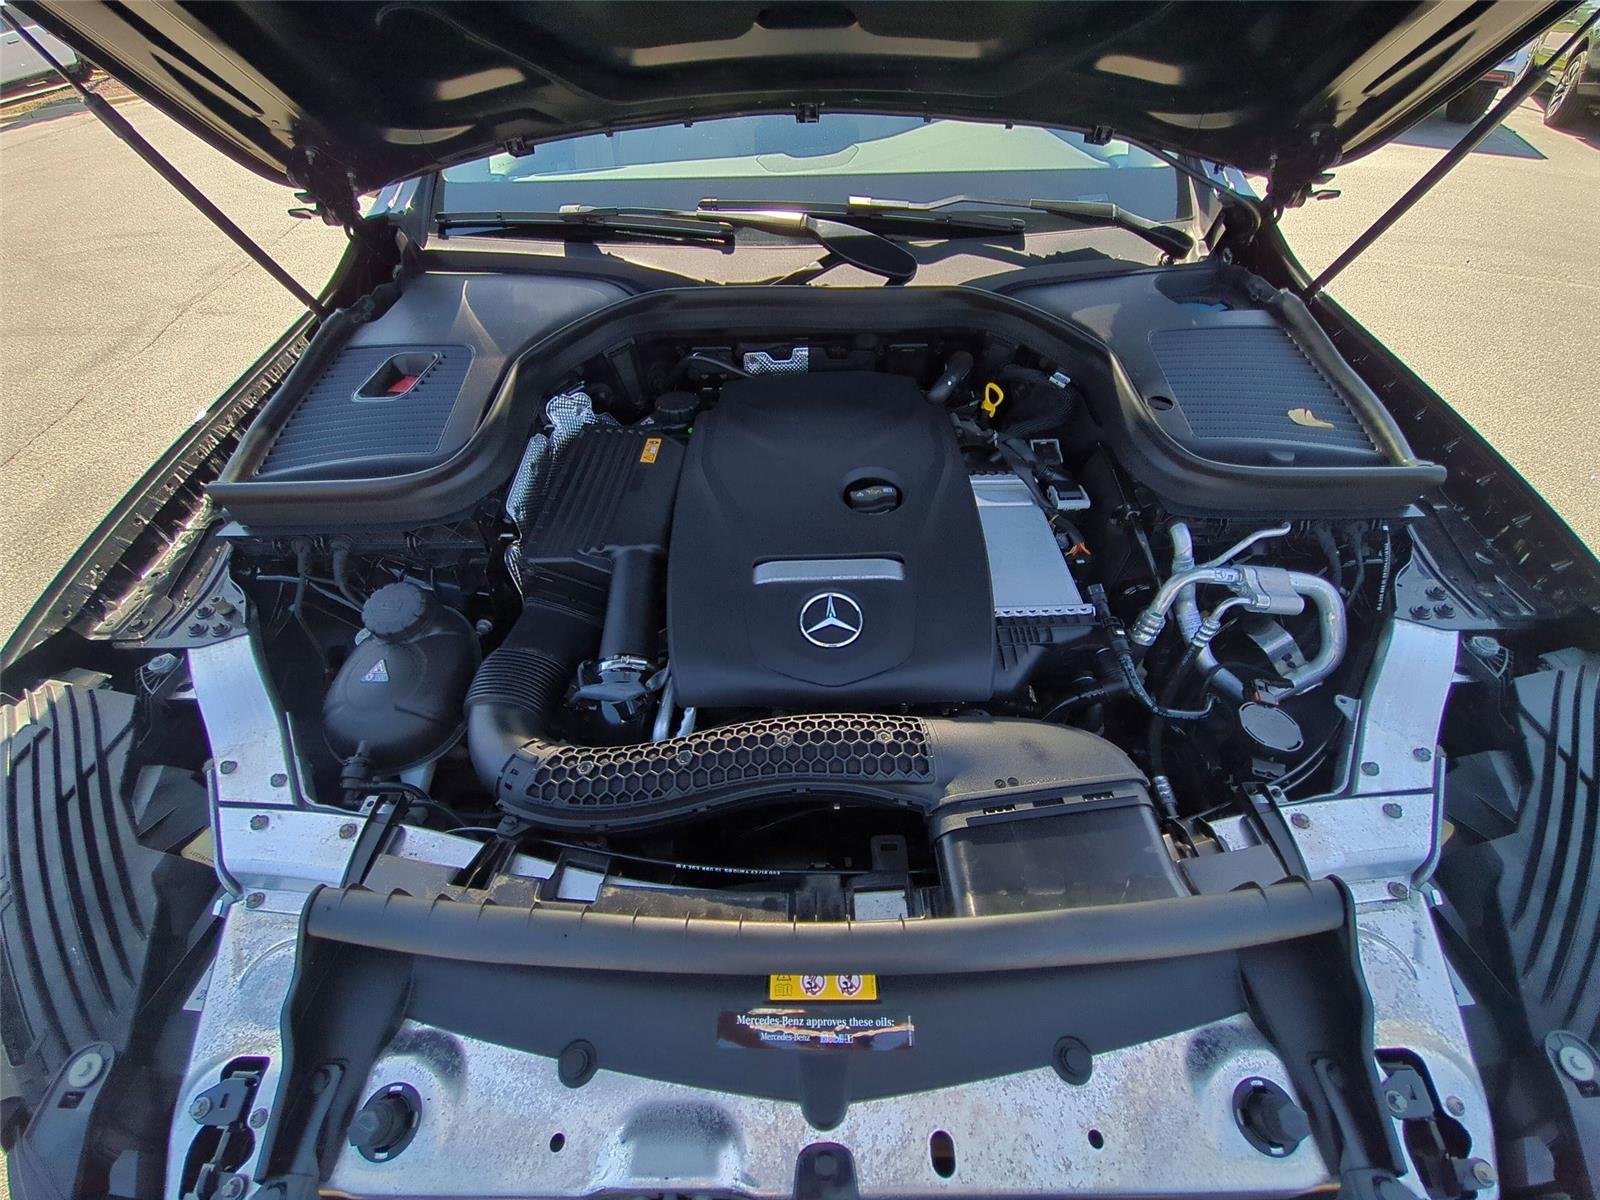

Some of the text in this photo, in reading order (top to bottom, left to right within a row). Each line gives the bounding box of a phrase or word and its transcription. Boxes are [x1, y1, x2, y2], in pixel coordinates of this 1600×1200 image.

[736, 1015, 895, 1029] Mercedes-Benz approves these oils:
[760, 1032, 810, 1042] Mercedes-Benz
